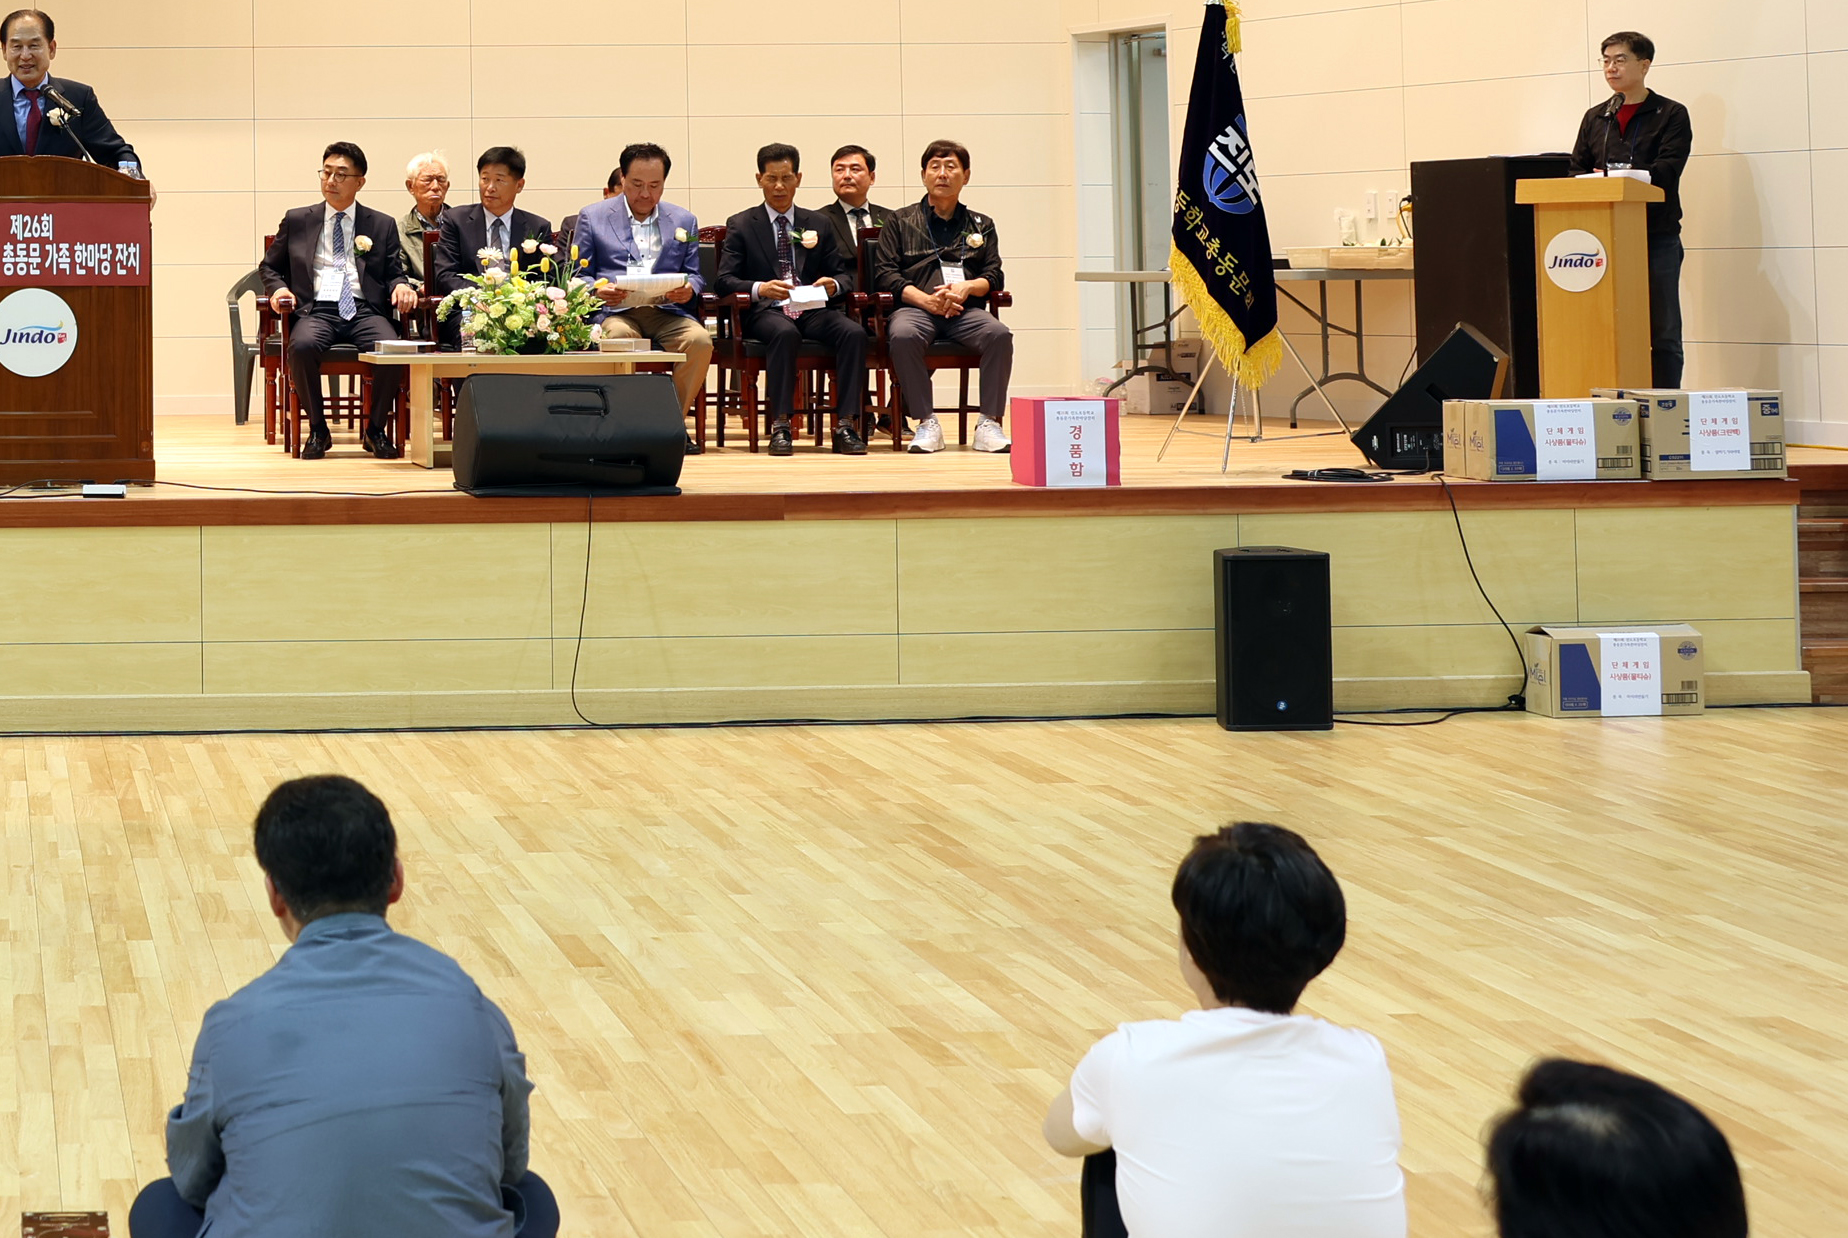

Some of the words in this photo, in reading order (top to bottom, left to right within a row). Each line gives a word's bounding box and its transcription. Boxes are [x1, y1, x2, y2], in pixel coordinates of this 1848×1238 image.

[9, 213, 54, 241] 제26회
[2, 243, 41, 276] 총동문
[45, 242, 70, 275] 가족
[74, 242, 112, 276] 한마당
[115, 242, 140, 275] 잔치
[1548, 255, 1594, 270] Jindo
[0, 328, 55, 345] Jindo
